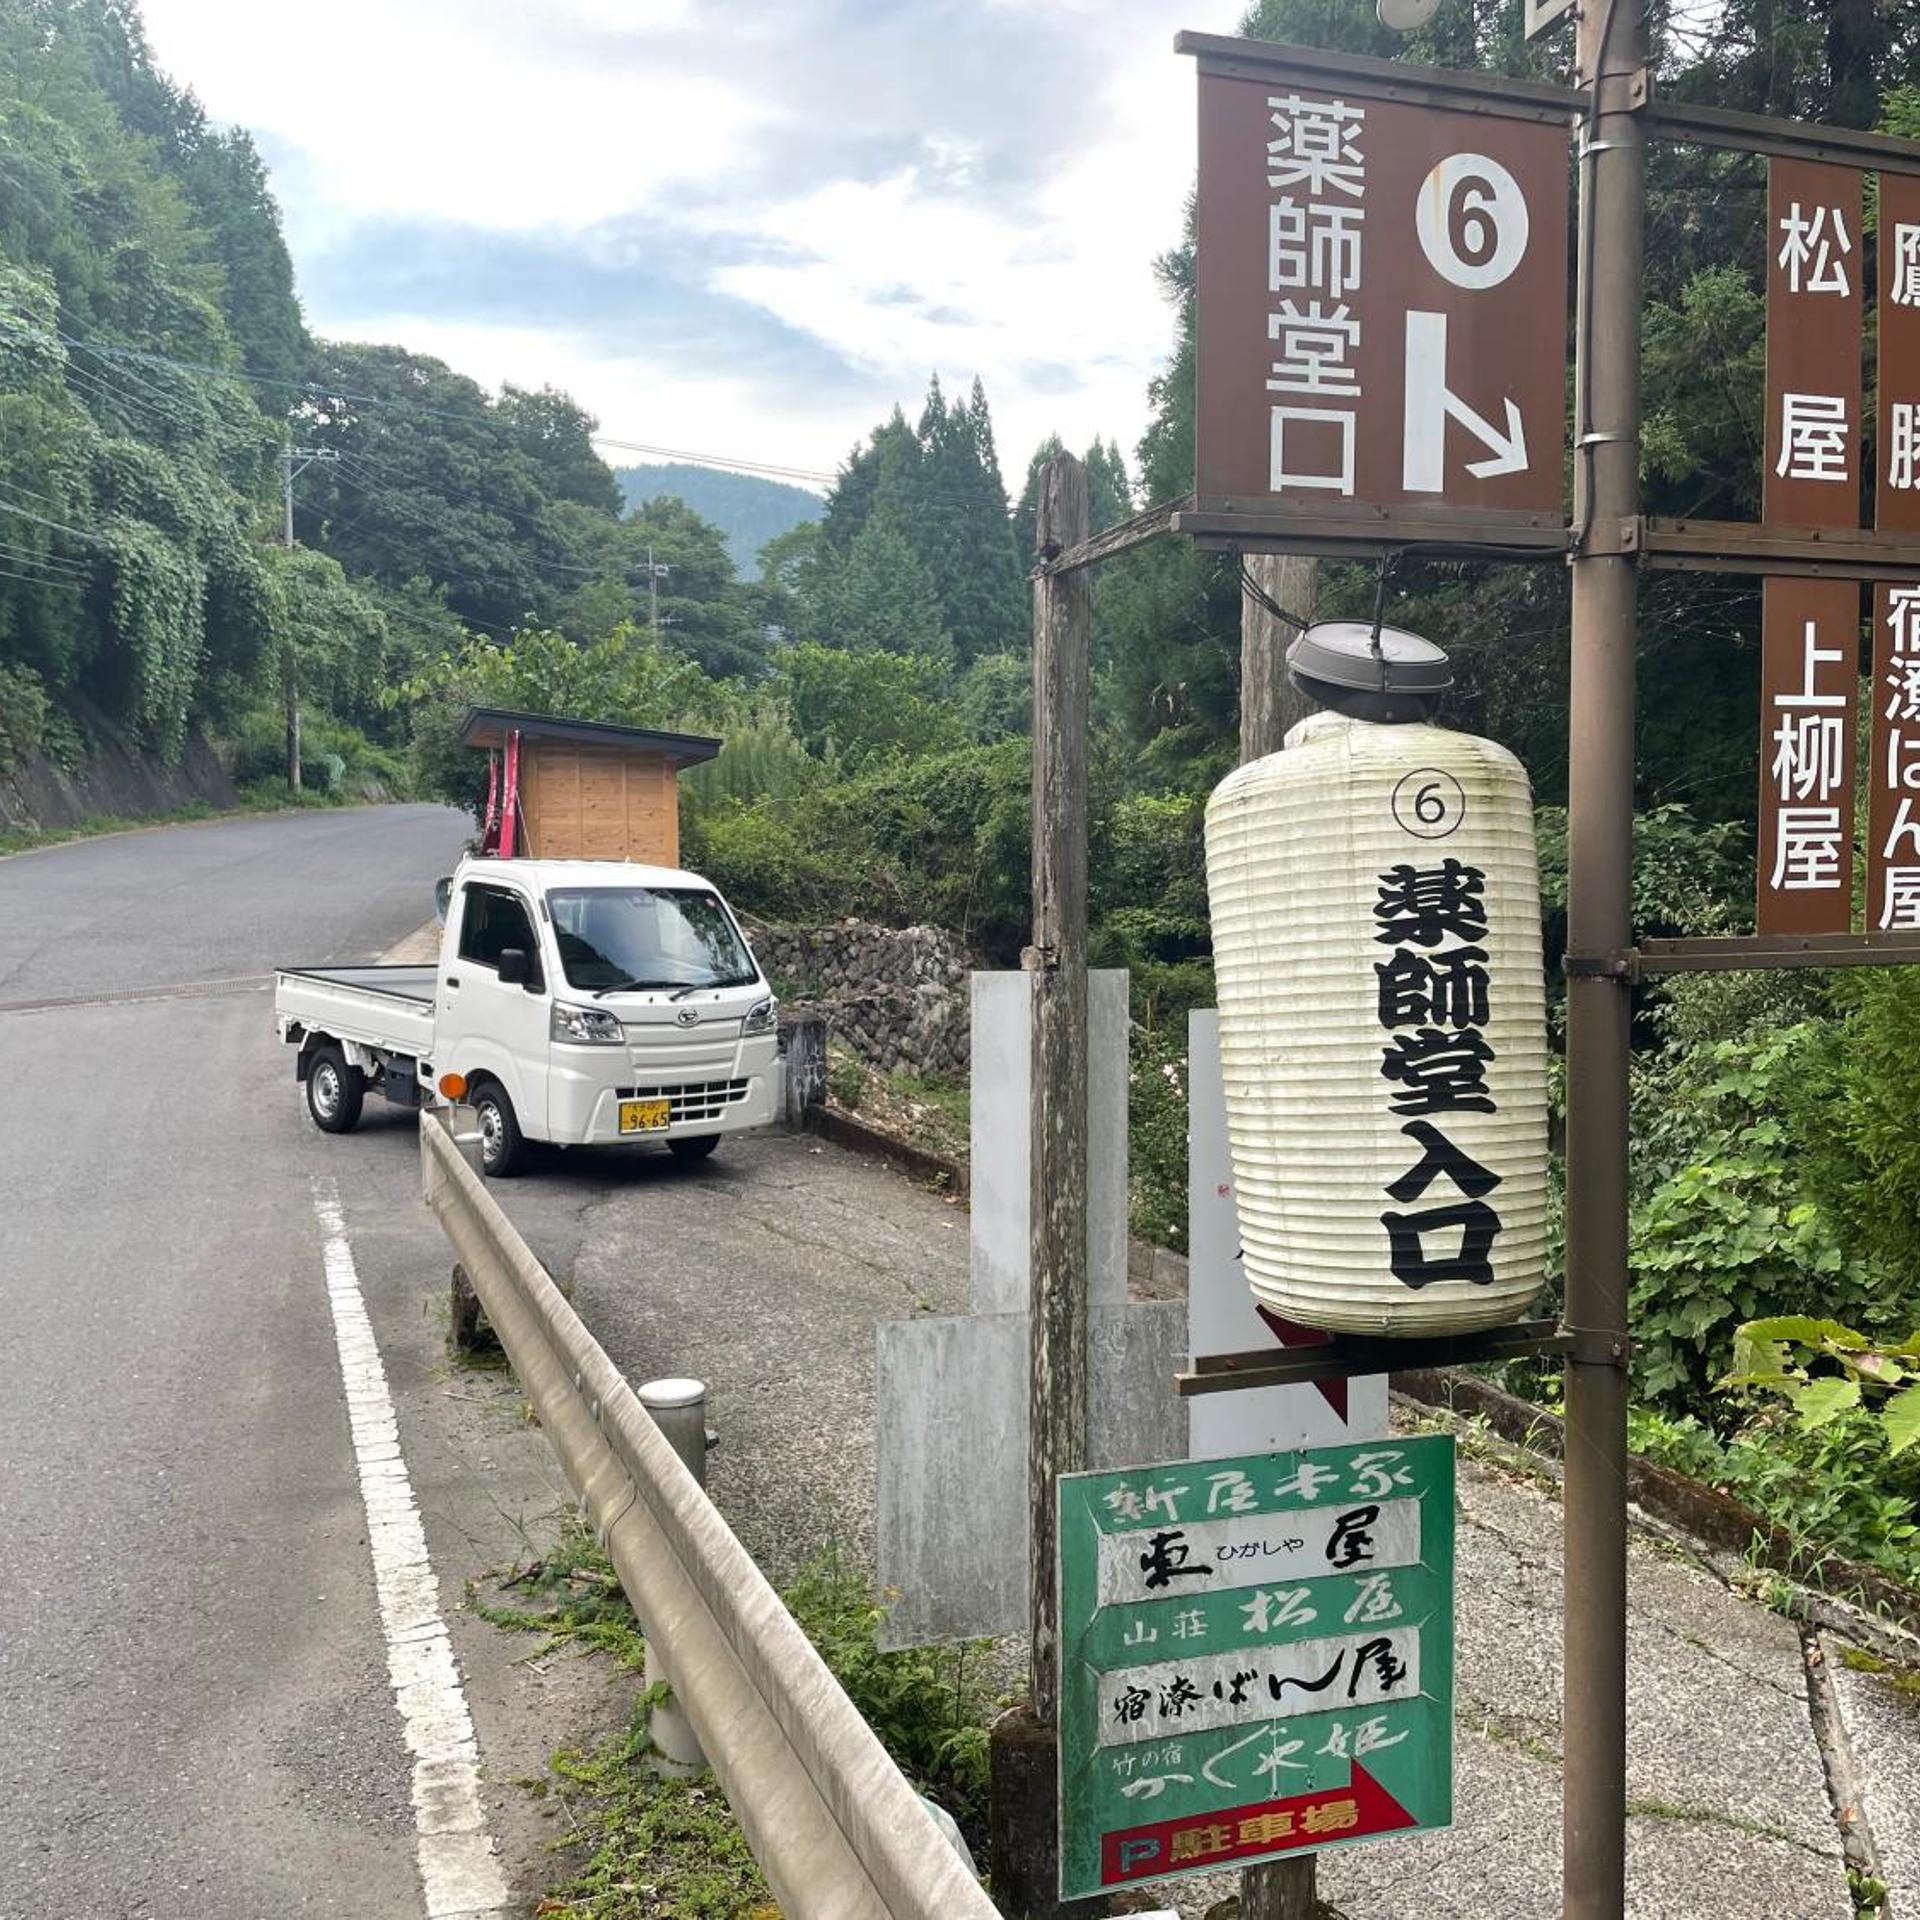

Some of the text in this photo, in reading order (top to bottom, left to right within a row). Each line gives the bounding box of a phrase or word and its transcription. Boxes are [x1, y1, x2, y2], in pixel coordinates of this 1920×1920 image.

[1266, 95, 1365, 496] 薬師堂口
[1776, 203, 1852, 482] 松屋
[1770, 621, 1847, 891] 上柳屋
[1373, 858, 1503, 1290] 薬師堂入口
[1112, 1742, 1183, 1776] 竹の宿
